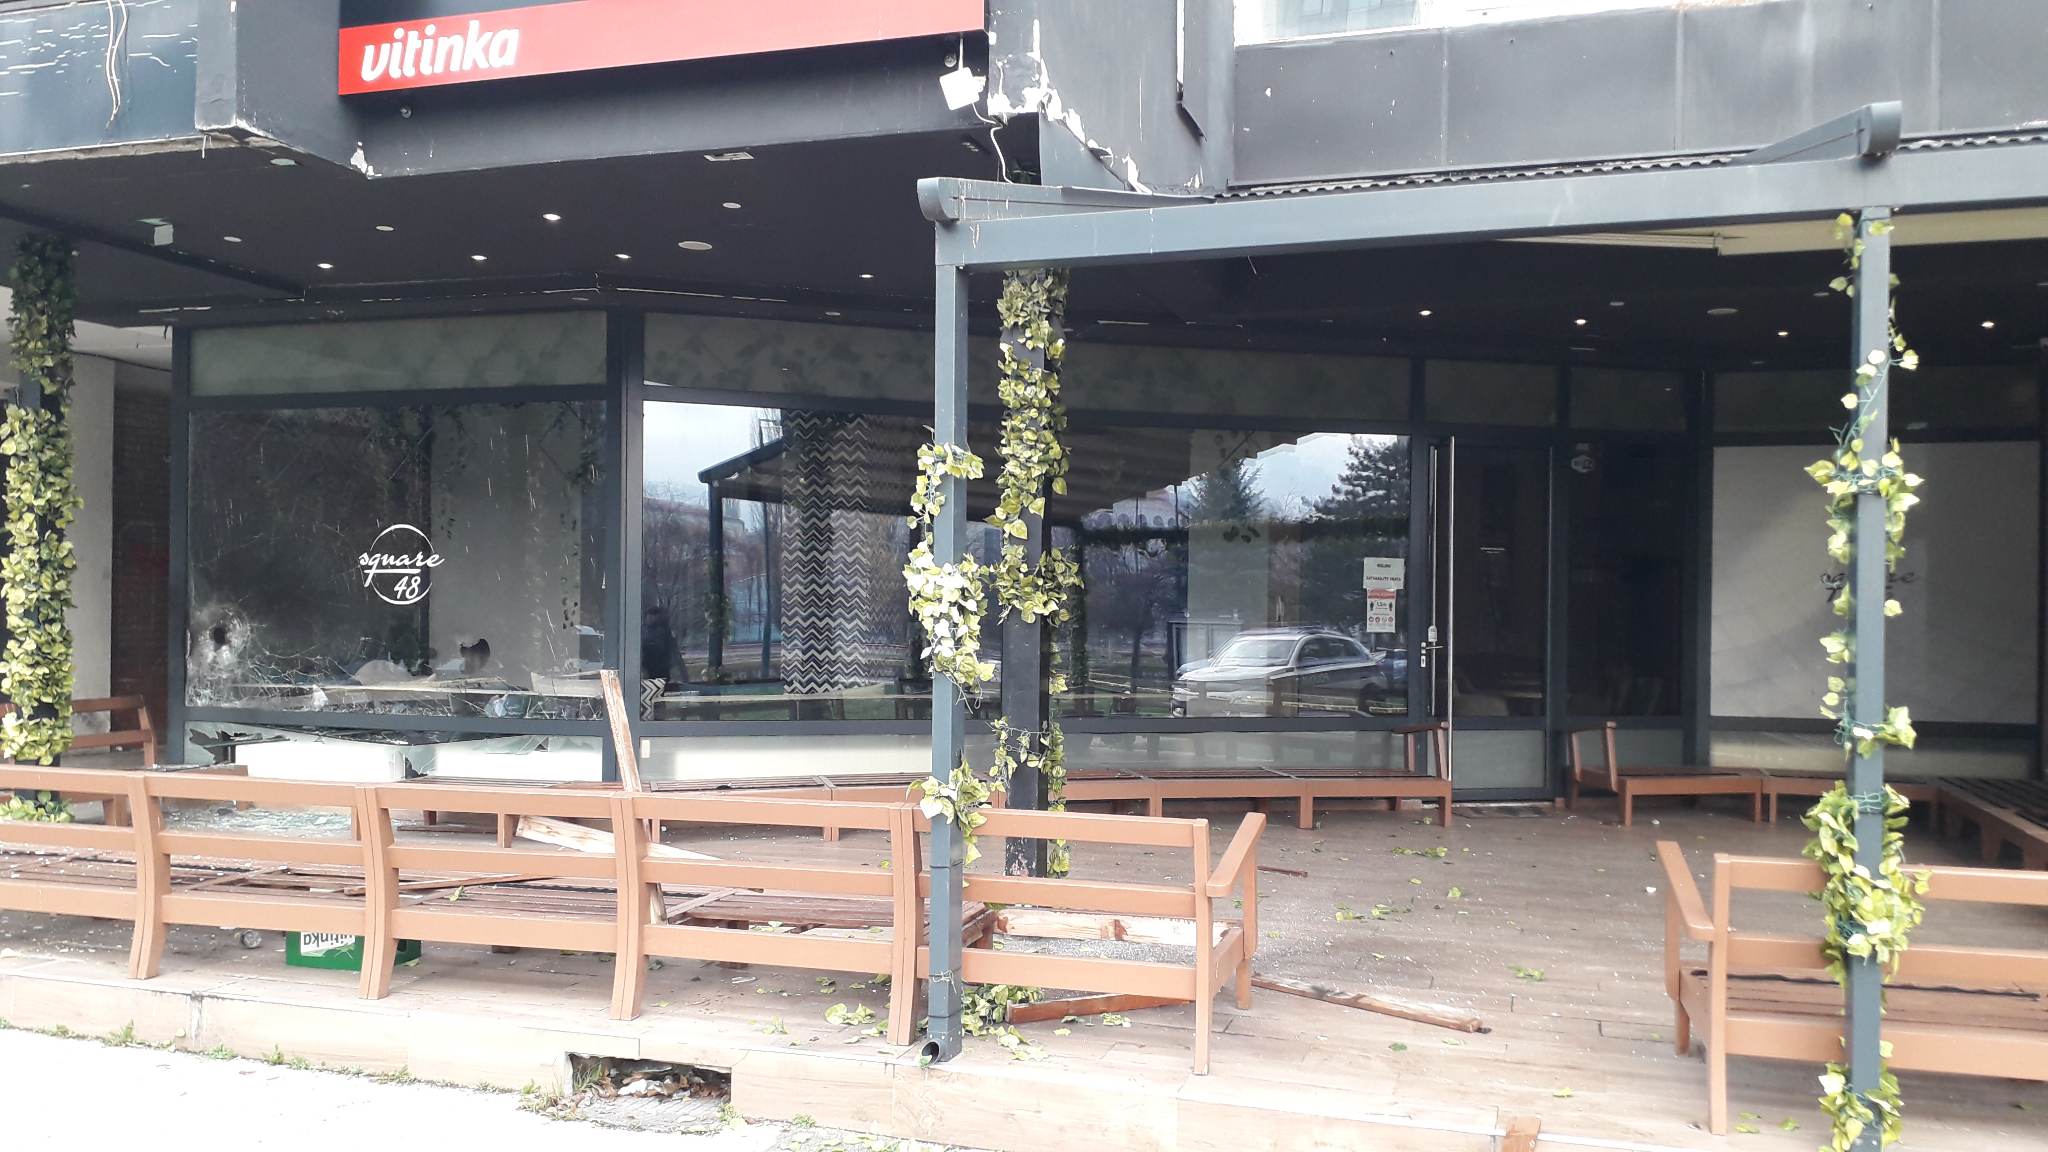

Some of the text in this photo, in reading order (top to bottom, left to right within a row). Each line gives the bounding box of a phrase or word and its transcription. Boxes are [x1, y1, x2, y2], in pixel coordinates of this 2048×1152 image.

[361, 19, 519, 82] vitinka
[358, 551, 445, 588] square
[393, 575, 421, 600] 48
